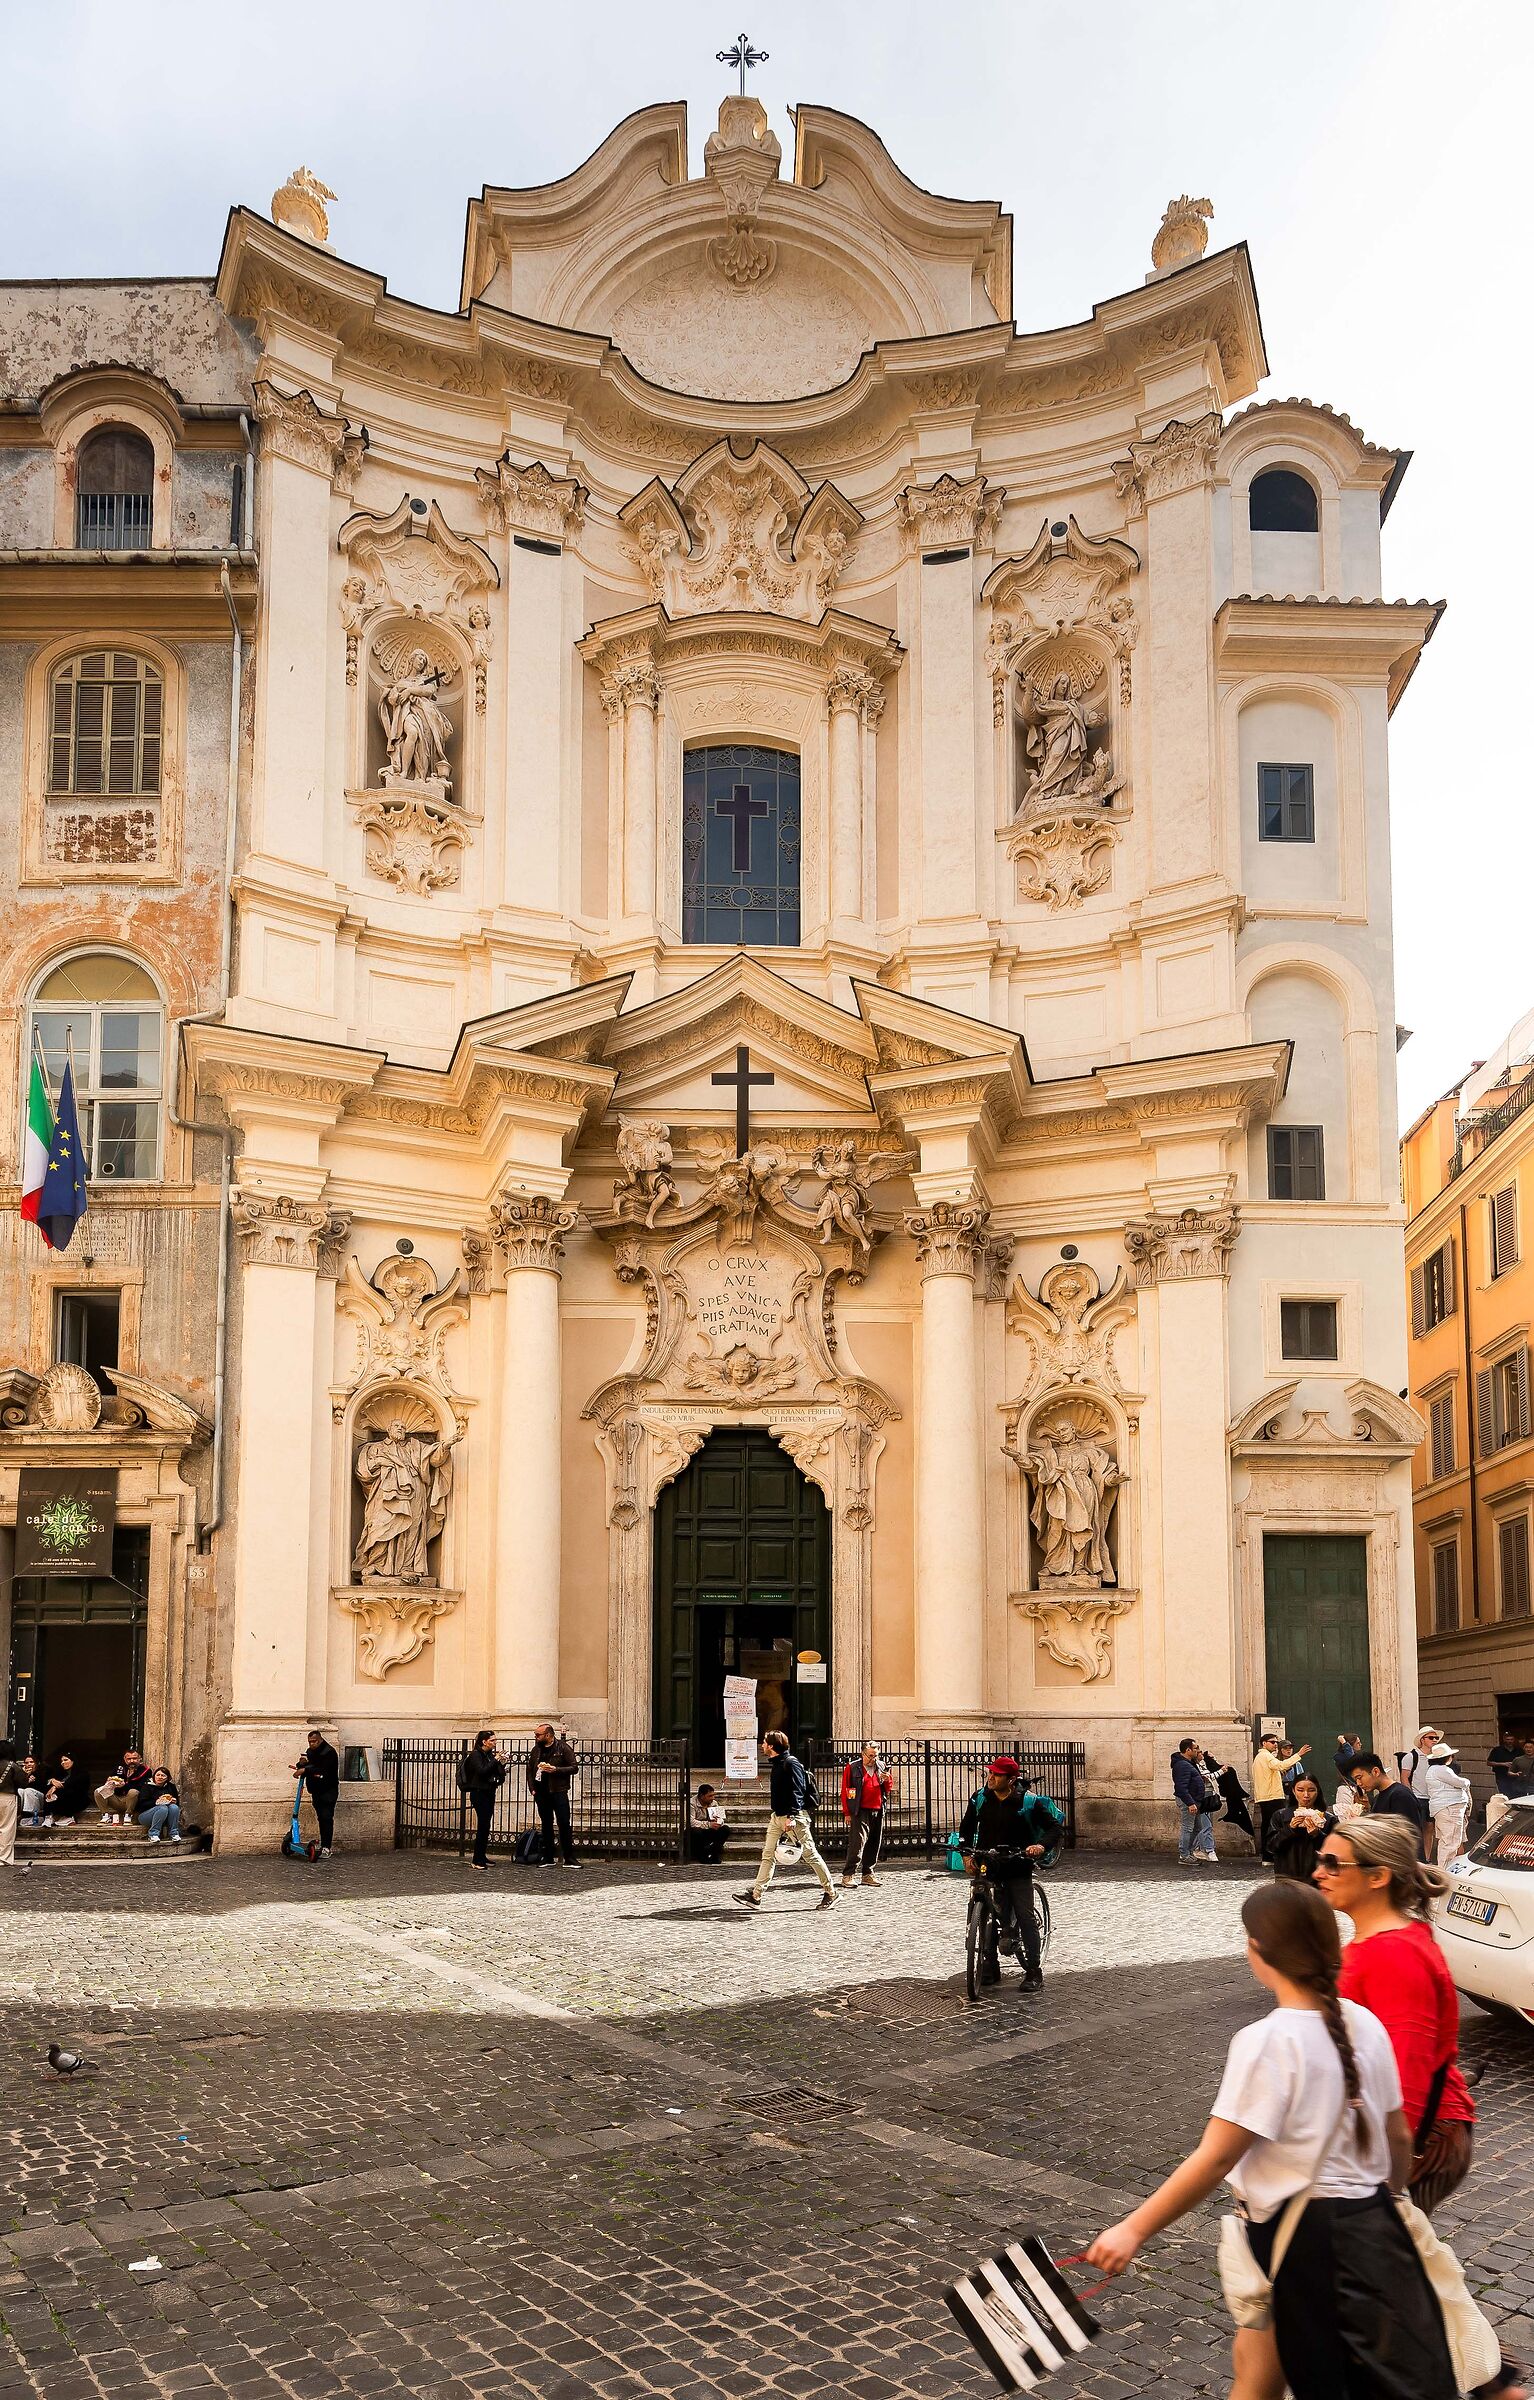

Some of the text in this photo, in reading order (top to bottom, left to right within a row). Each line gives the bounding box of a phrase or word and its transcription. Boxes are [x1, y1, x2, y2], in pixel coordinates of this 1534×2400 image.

[708, 1256, 768, 1272] O CRVX
[724, 1275, 756, 1287] AVE
[698, 1291, 782, 1308] SPES VNICA
[702, 1304, 777, 1324] PIIS ADAVGE
[708, 1320, 769, 1337] GRATIAM
[690, 1407, 724, 1415] PLENARIA
[761, 1408, 806, 1416] QUOTIDIANA
[190, 1567, 205, 1578] 53
[1457, 1883, 1473, 1894] ZOE
